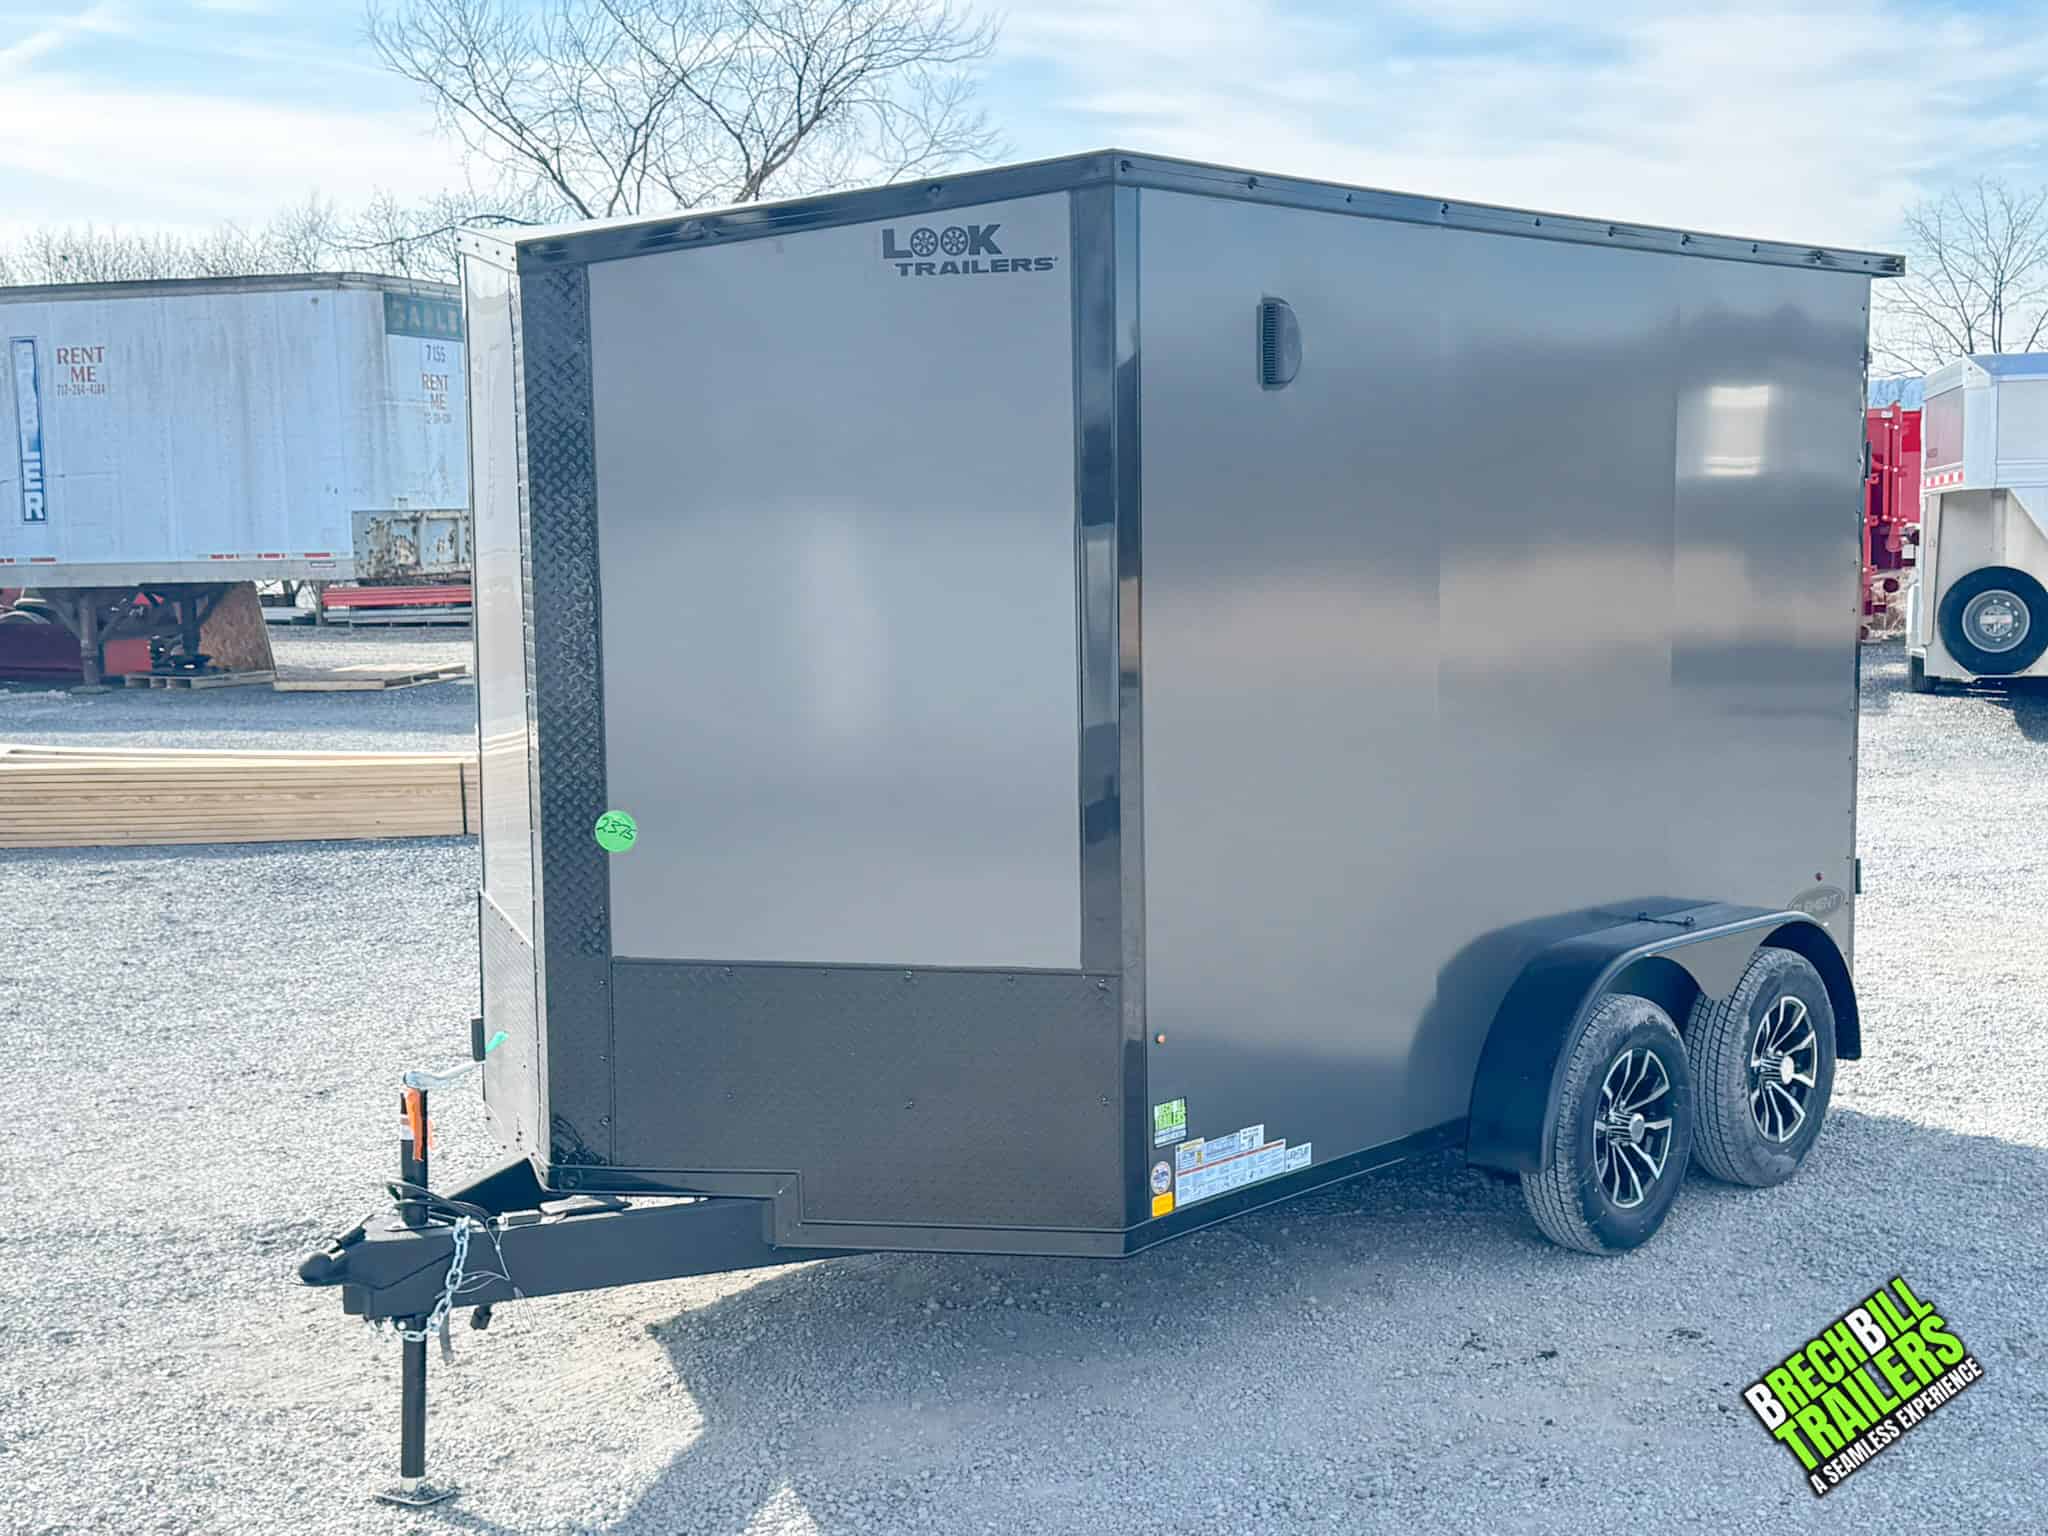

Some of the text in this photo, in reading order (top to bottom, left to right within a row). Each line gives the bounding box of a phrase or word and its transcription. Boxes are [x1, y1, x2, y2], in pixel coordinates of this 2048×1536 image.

[882, 224, 1002, 259] LOOK
[895, 256, 1057, 277] TRAILERS
[56, 346, 105, 365] RENT
[71, 366, 96, 383] ME
[422, 373, 448, 391] RENT
[431, 392, 447, 410] ME
